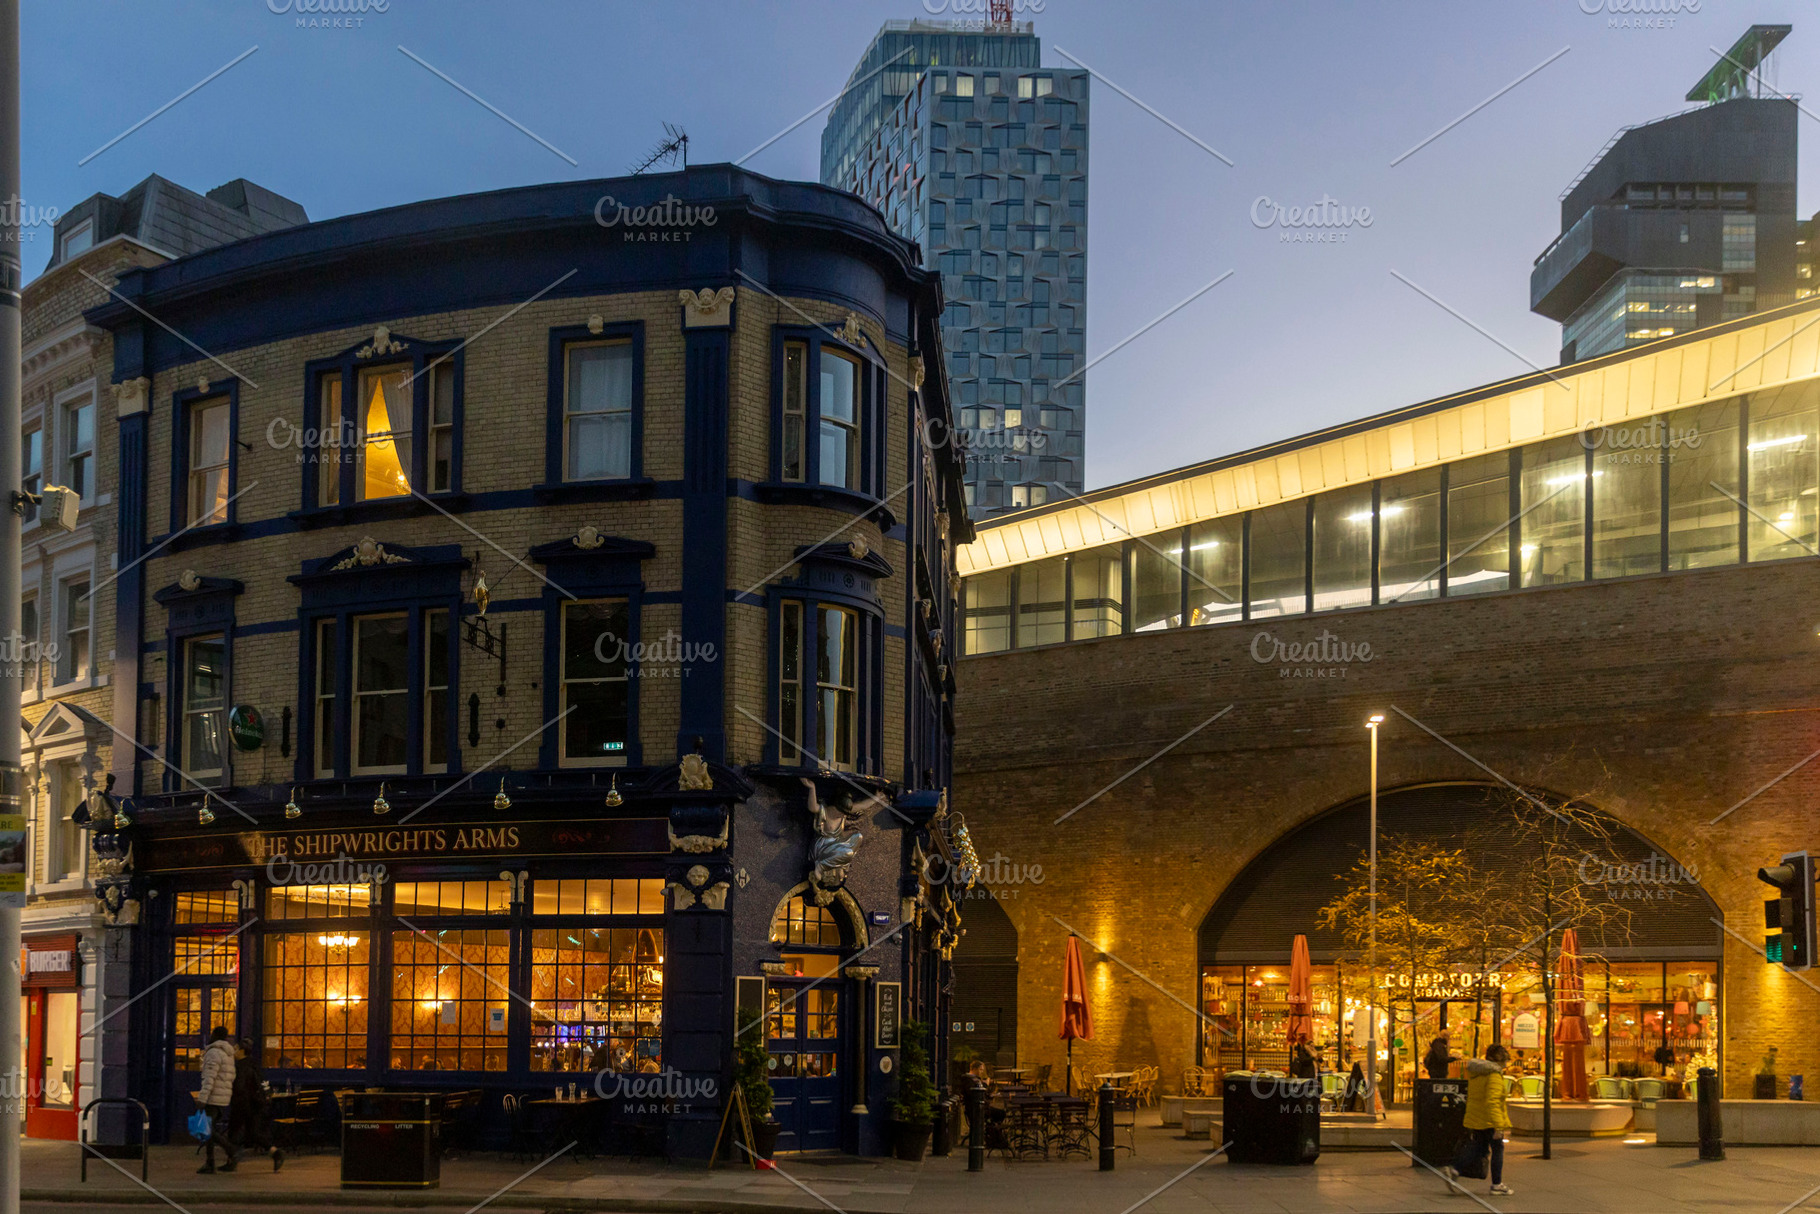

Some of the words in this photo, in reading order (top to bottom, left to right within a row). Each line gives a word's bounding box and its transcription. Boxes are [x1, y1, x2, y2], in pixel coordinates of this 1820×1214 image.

[249, 834, 288, 857] THE
[294, 829, 447, 856] SHIPWRIGHTS
[453, 826, 520, 849] ARMS
[30, 951, 71, 972] BURGER
